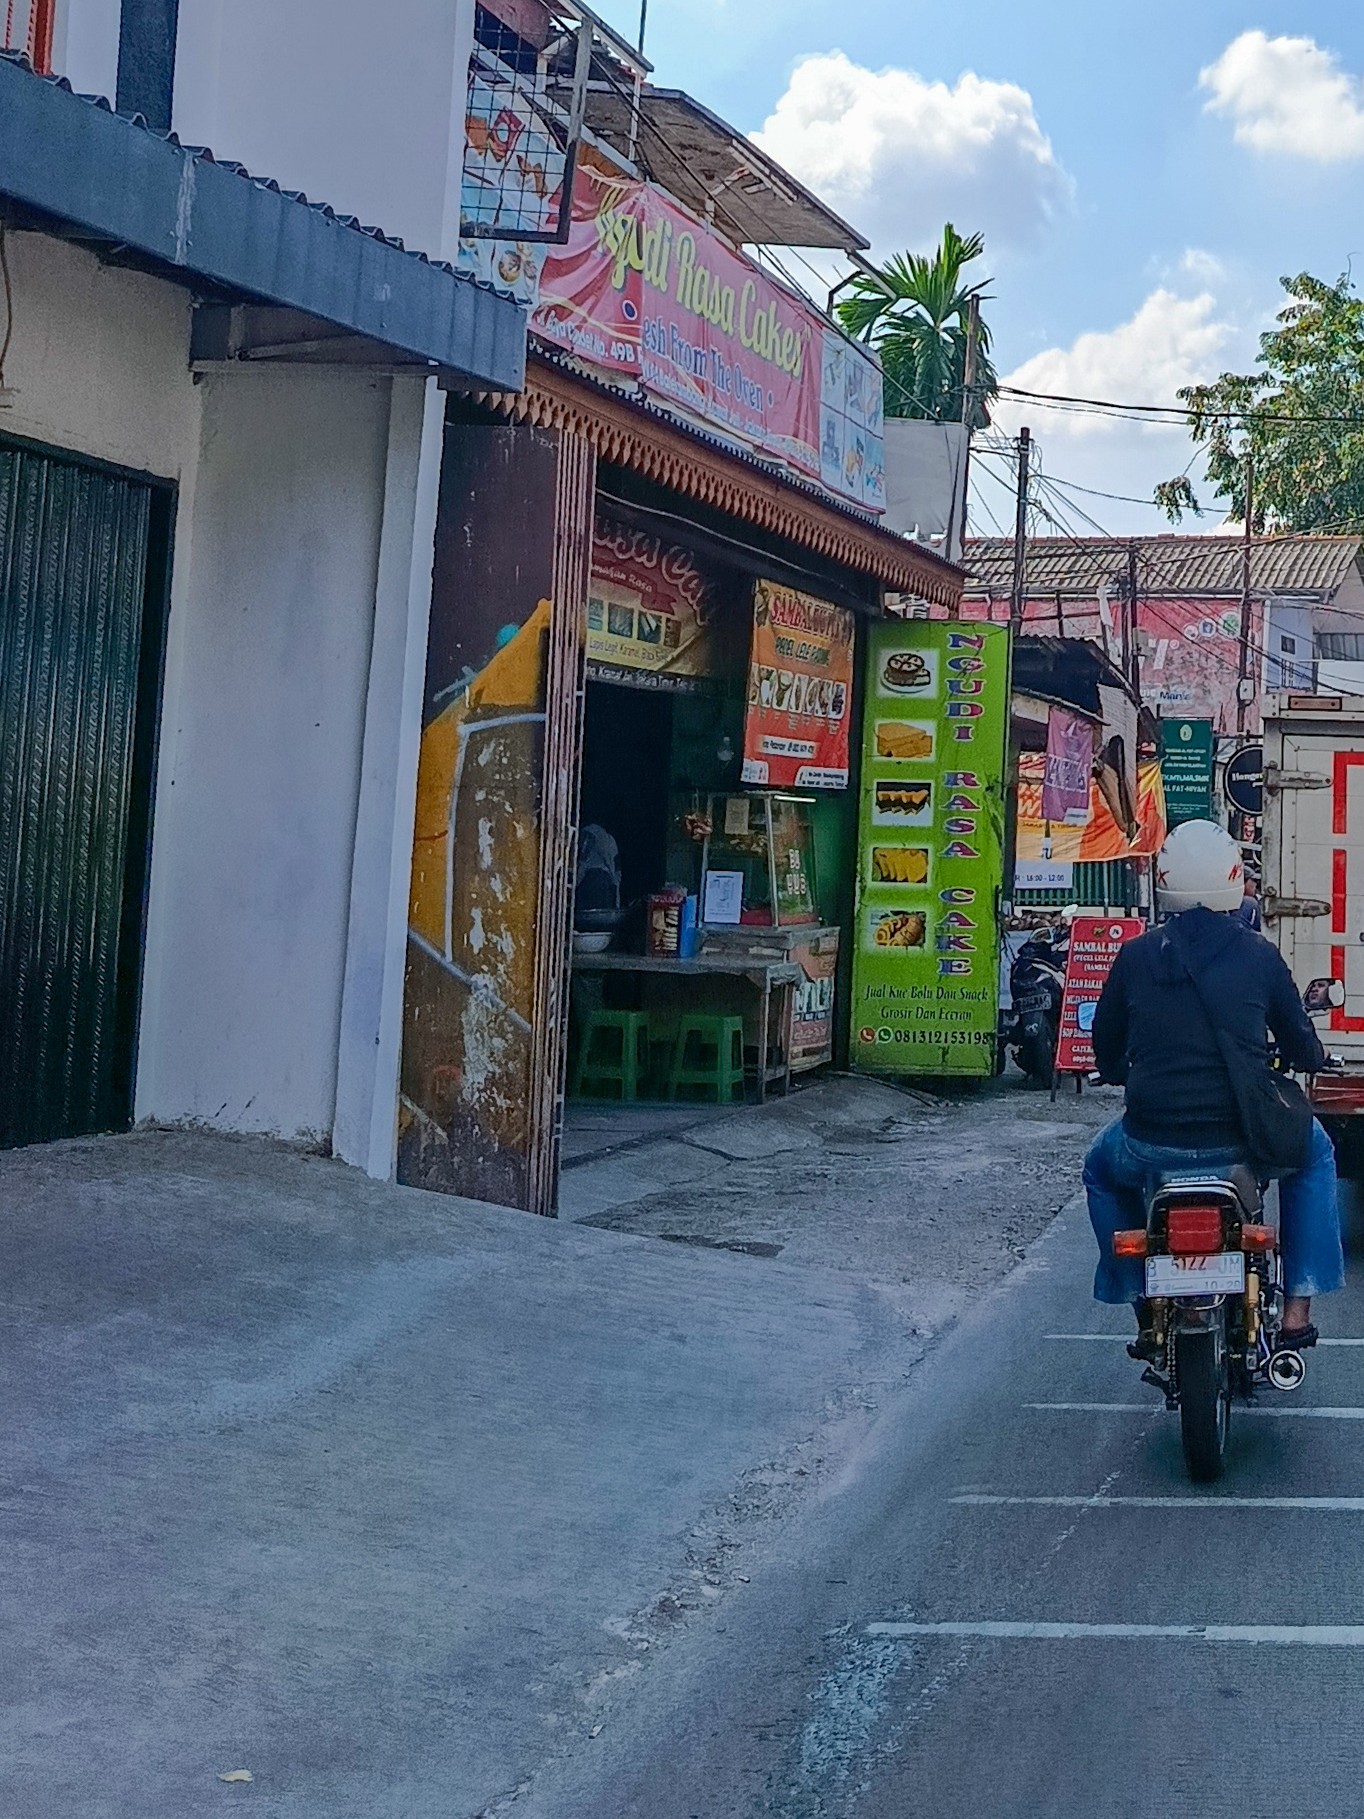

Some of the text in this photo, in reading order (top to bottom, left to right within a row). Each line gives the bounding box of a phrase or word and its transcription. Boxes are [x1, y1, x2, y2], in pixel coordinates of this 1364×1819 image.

[676, 230, 736, 338] Rasa
[610, 340, 635, 362] 49B
[670, 320, 708, 380] From
[709, 342, 731, 395] The
[733, 361, 764, 416] Oven
[629, 573, 653, 593] Rasa
[945, 631, 986, 743] NGUDI
[938, 770, 983, 860] RASA
[934, 886, 980, 976] CAKE
[1073, 941, 1106, 953] SAMBAL
[864, 984, 988, 1001] Jual Kue Bolu Dan Snack
[881, 1005, 912, 1020] Grosir
[915, 1006, 936, 1021] Dan
[1171, 1175, 1219, 1183] HONDA
